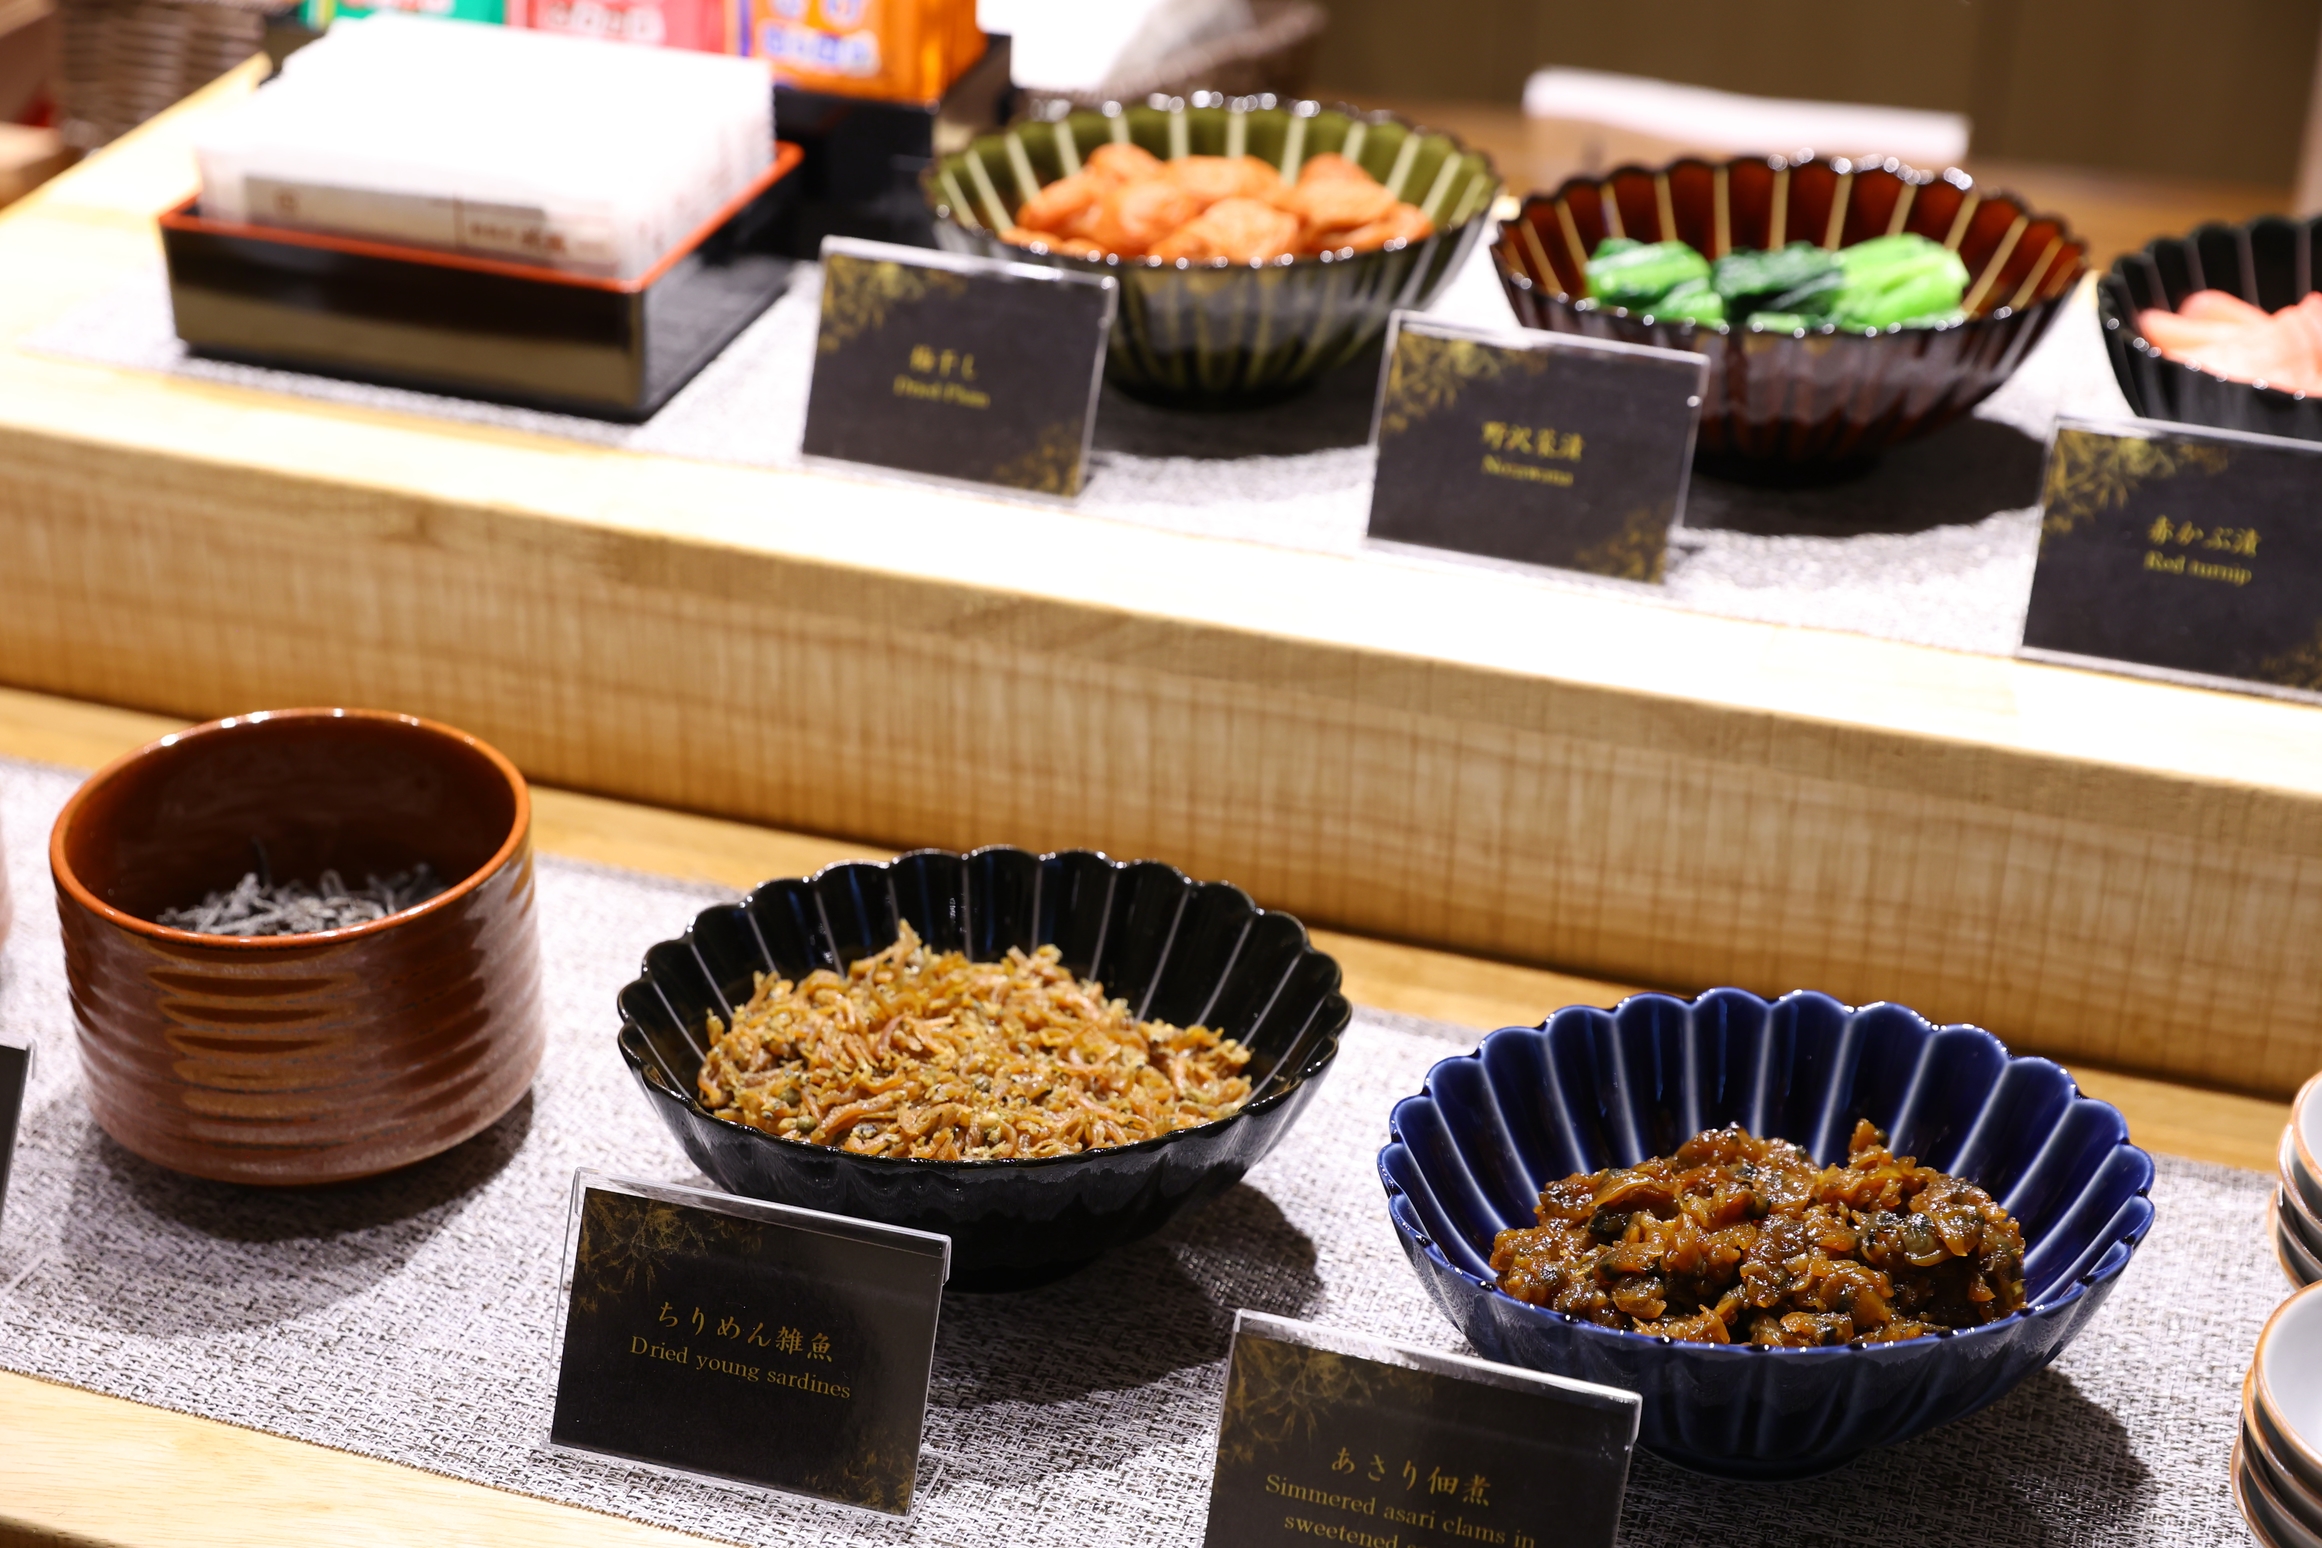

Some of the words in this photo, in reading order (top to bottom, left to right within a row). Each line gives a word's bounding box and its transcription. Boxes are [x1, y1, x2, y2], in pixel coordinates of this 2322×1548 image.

[2148, 514, 2262, 558] 赤かぶ漬
[2144, 551, 2186, 575] Red
[2188, 559, 2252, 587] turnip
[658, 1301, 833, 1363] ちりめん雑魚
[630, 1335, 688, 1364] Dried
[696, 1354, 761, 1382] young
[767, 1370, 851, 1399] sardines
[1331, 1447, 1491, 1507] あさり佃煮
[1265, 1474, 1376, 1516] Simmered
[1383, 1505, 1436, 1530] asari
[1443, 1516, 1506, 1544] clams
[1514, 1529, 1536, 1548] in
[1284, 1516, 1399, 1548] sweetened
